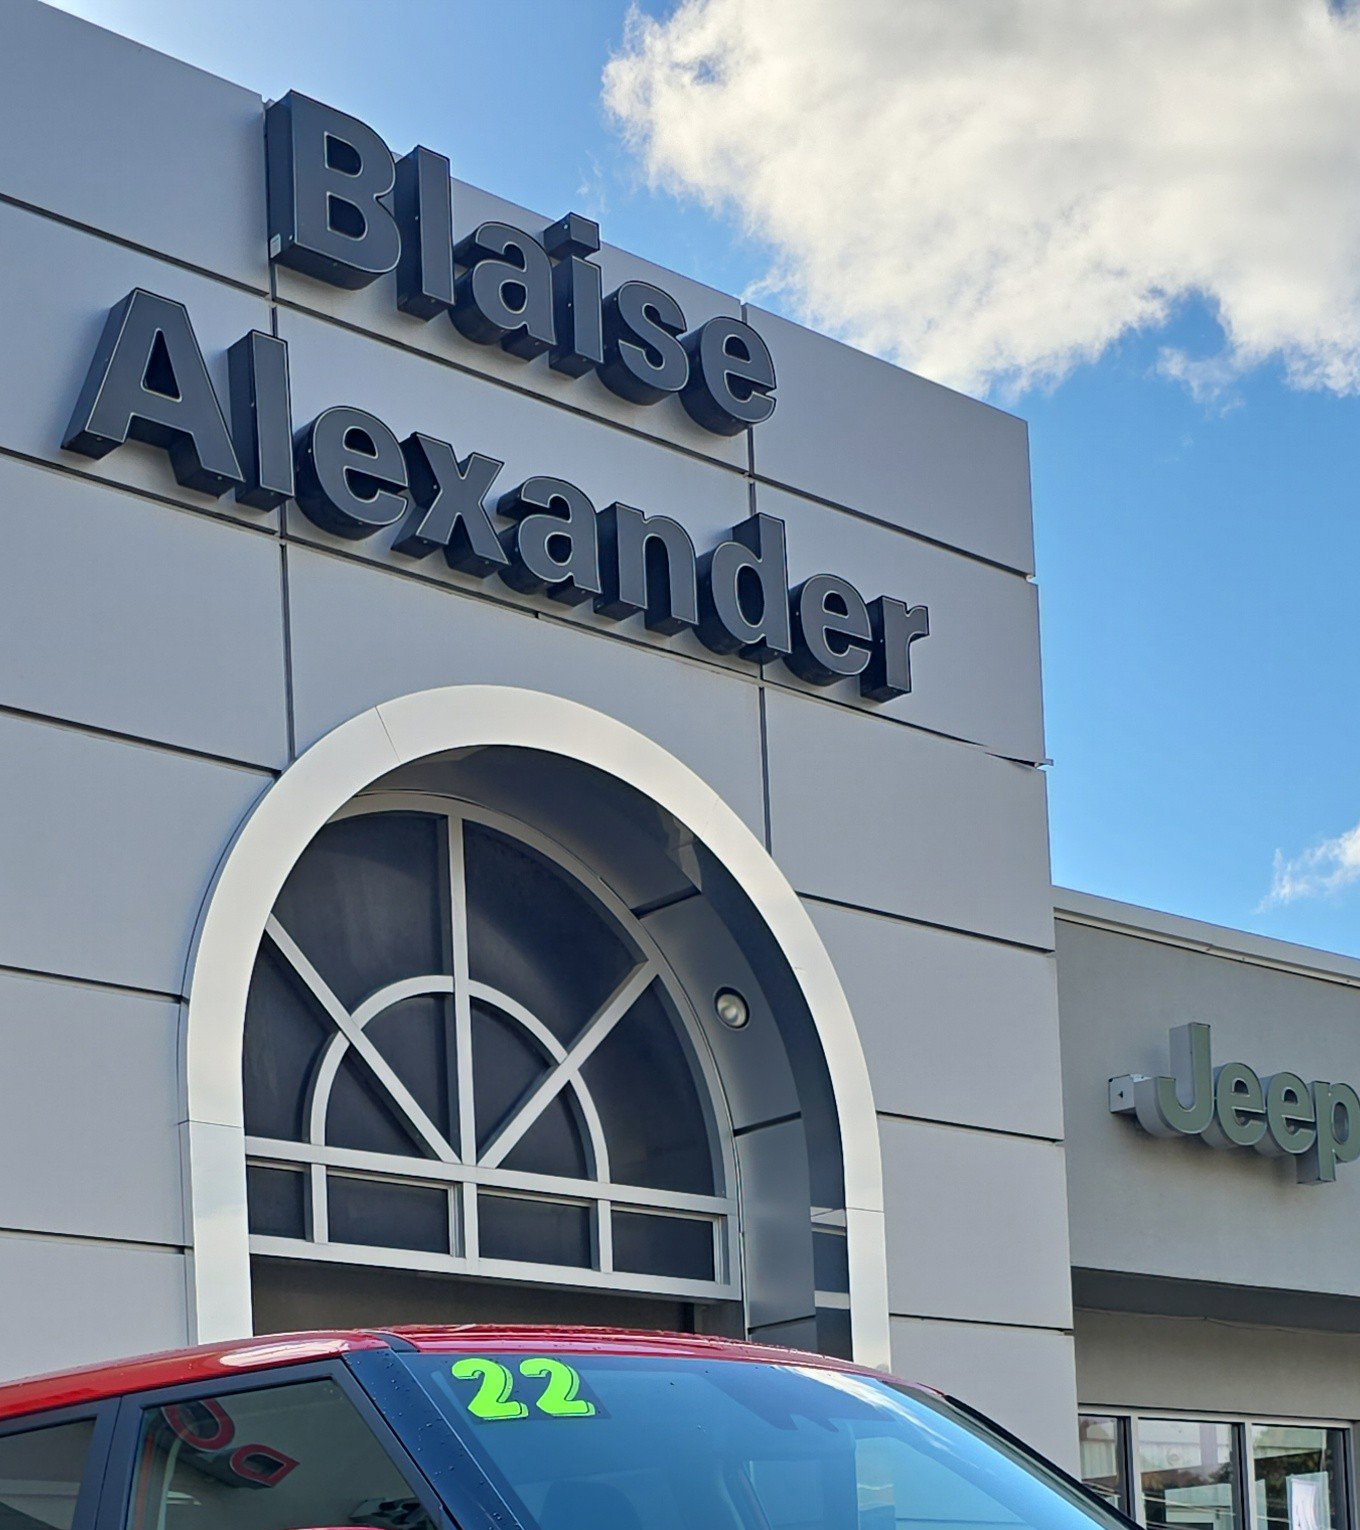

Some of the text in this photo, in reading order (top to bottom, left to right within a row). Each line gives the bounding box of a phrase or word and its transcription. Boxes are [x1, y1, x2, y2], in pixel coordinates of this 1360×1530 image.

[265, 90, 777, 436] Blaise
[60, 287, 930, 703] Alexander
[451, 1357, 596, 1421] 22
